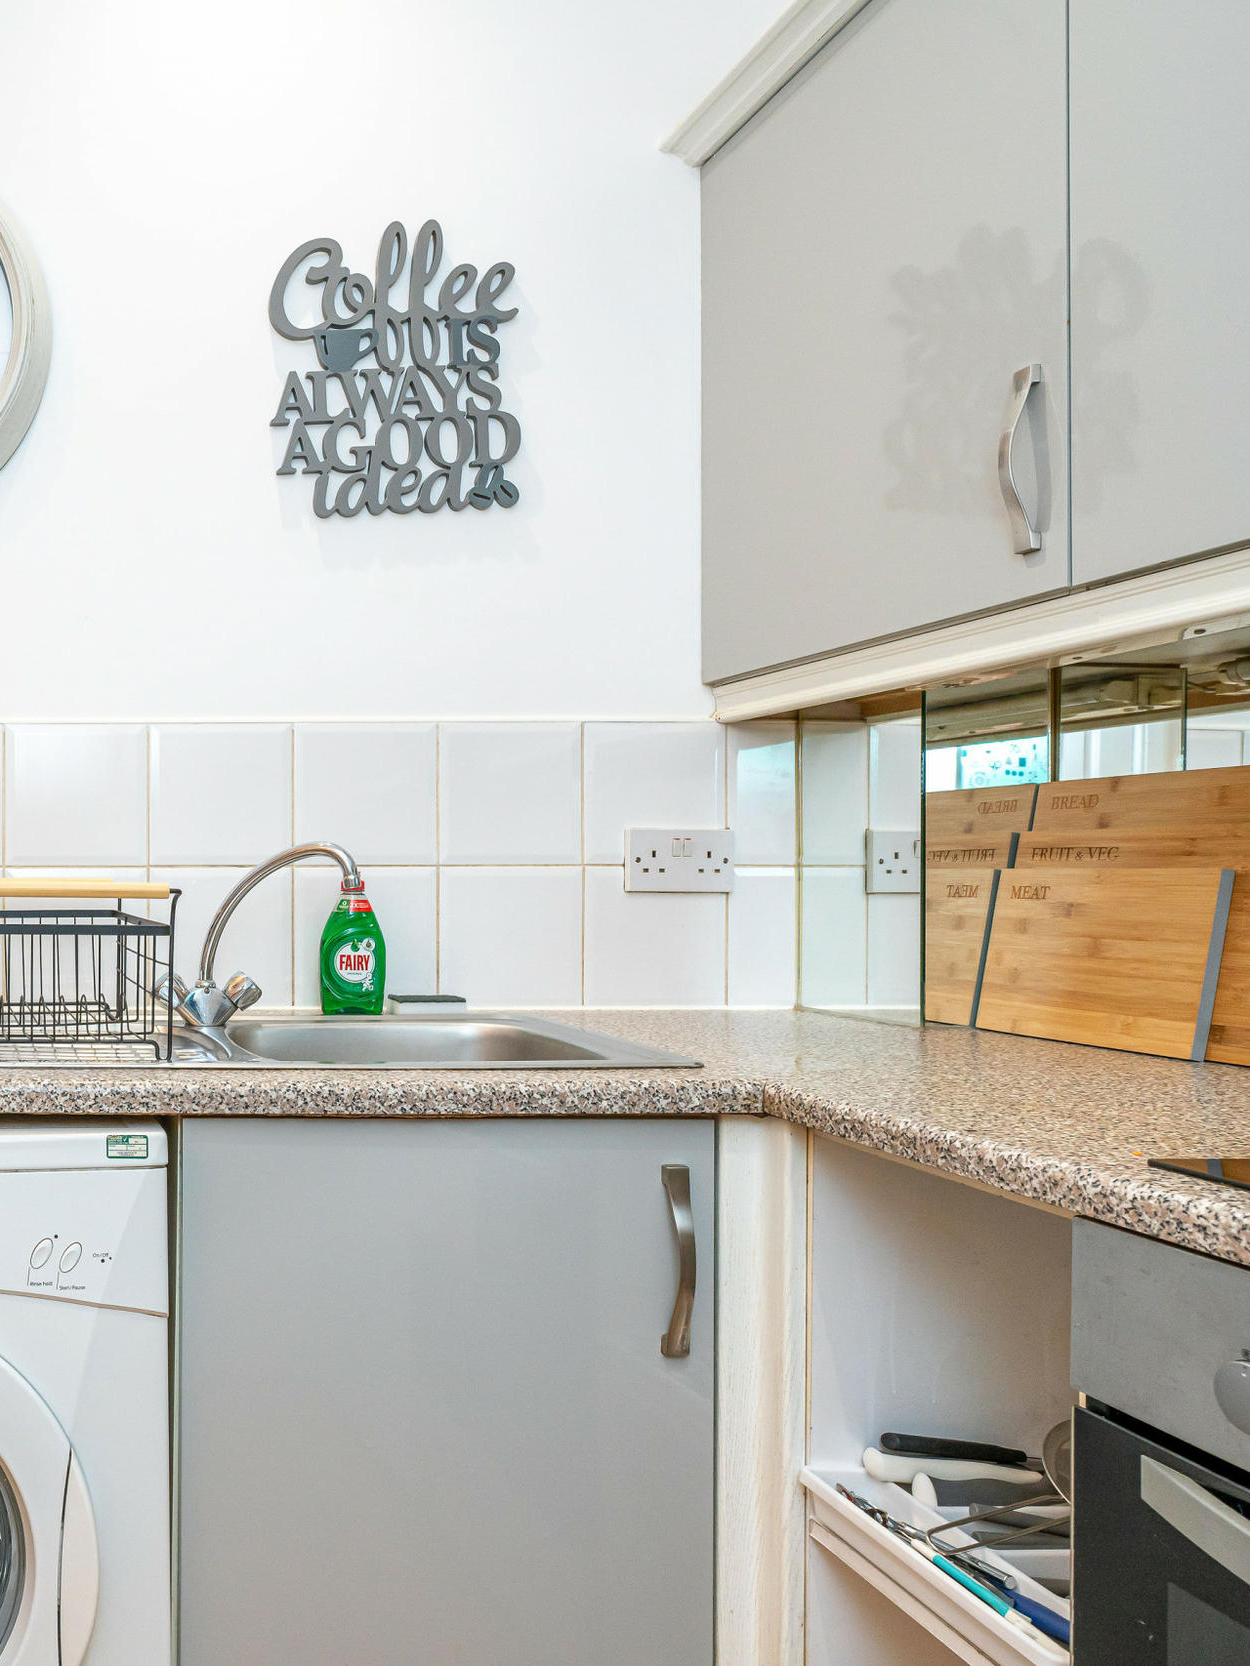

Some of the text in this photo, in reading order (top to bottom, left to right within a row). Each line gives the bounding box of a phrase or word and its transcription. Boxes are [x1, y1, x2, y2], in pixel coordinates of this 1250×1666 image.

[268, 219, 519, 371] Coffee
[447, 315, 502, 367] IS
[270, 364, 503, 428] ALWAYS
[276, 411, 522, 475] A GOOD
[312, 453, 471, 518] idea
[1051, 794, 1099, 810] BREAD
[1031, 847, 1120, 861] FRUIT & VEG
[1010, 885, 1051, 900] MEAT
[339, 954, 370, 971] FAIRY
